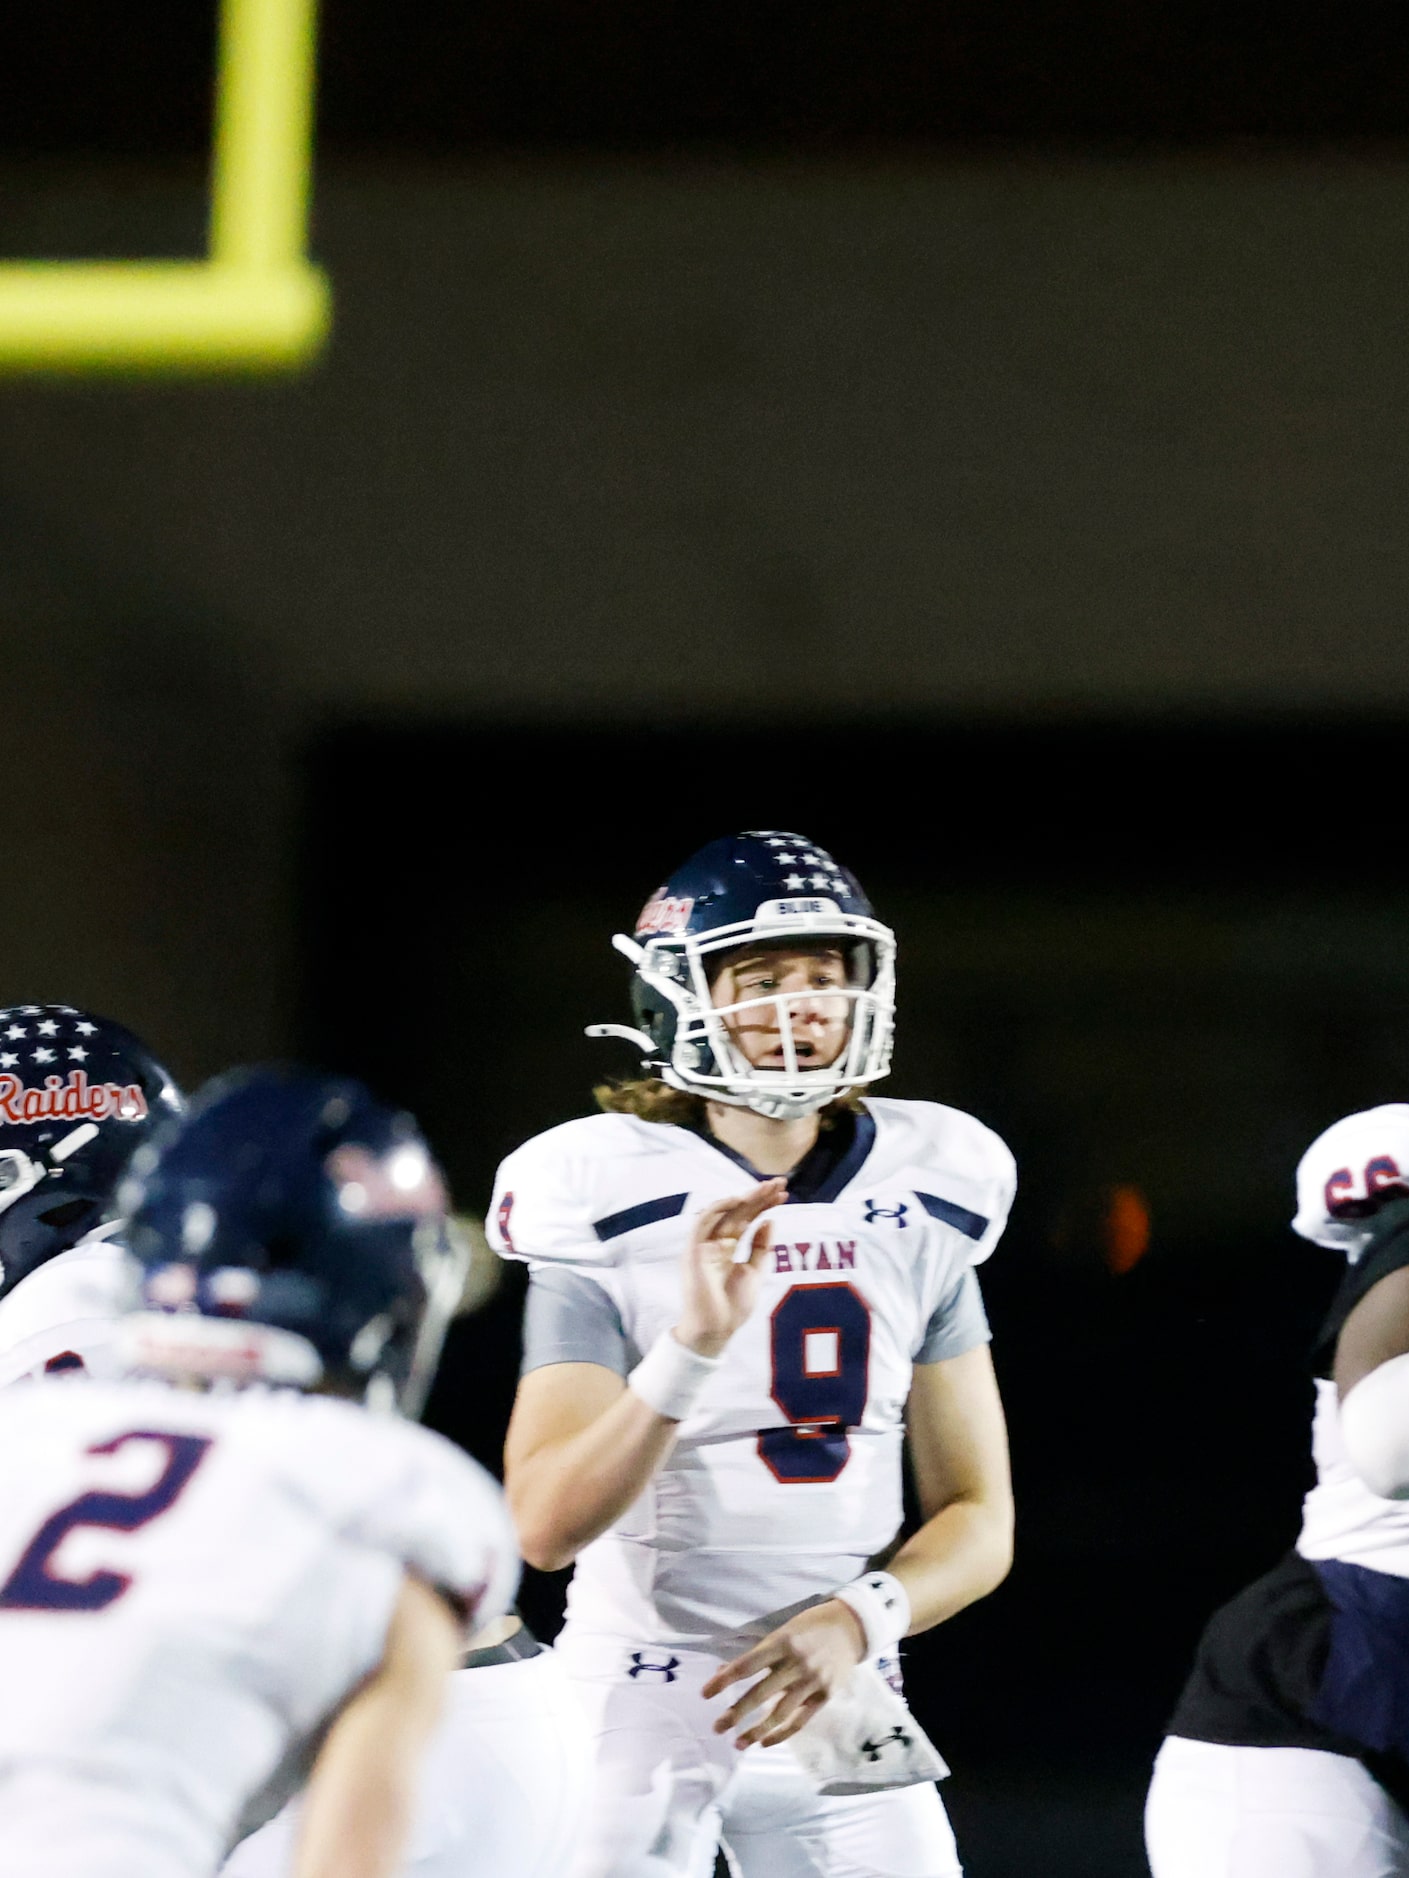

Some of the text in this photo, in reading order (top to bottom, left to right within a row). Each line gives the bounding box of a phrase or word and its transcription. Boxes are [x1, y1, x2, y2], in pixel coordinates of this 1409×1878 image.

[777, 900, 824, 915] BLUE
[0, 1069, 148, 1126] Raiders
[768, 1240, 858, 1273] RYAN
[757, 1280, 873, 1484] 9
[0, 1431, 213, 1612] 2
